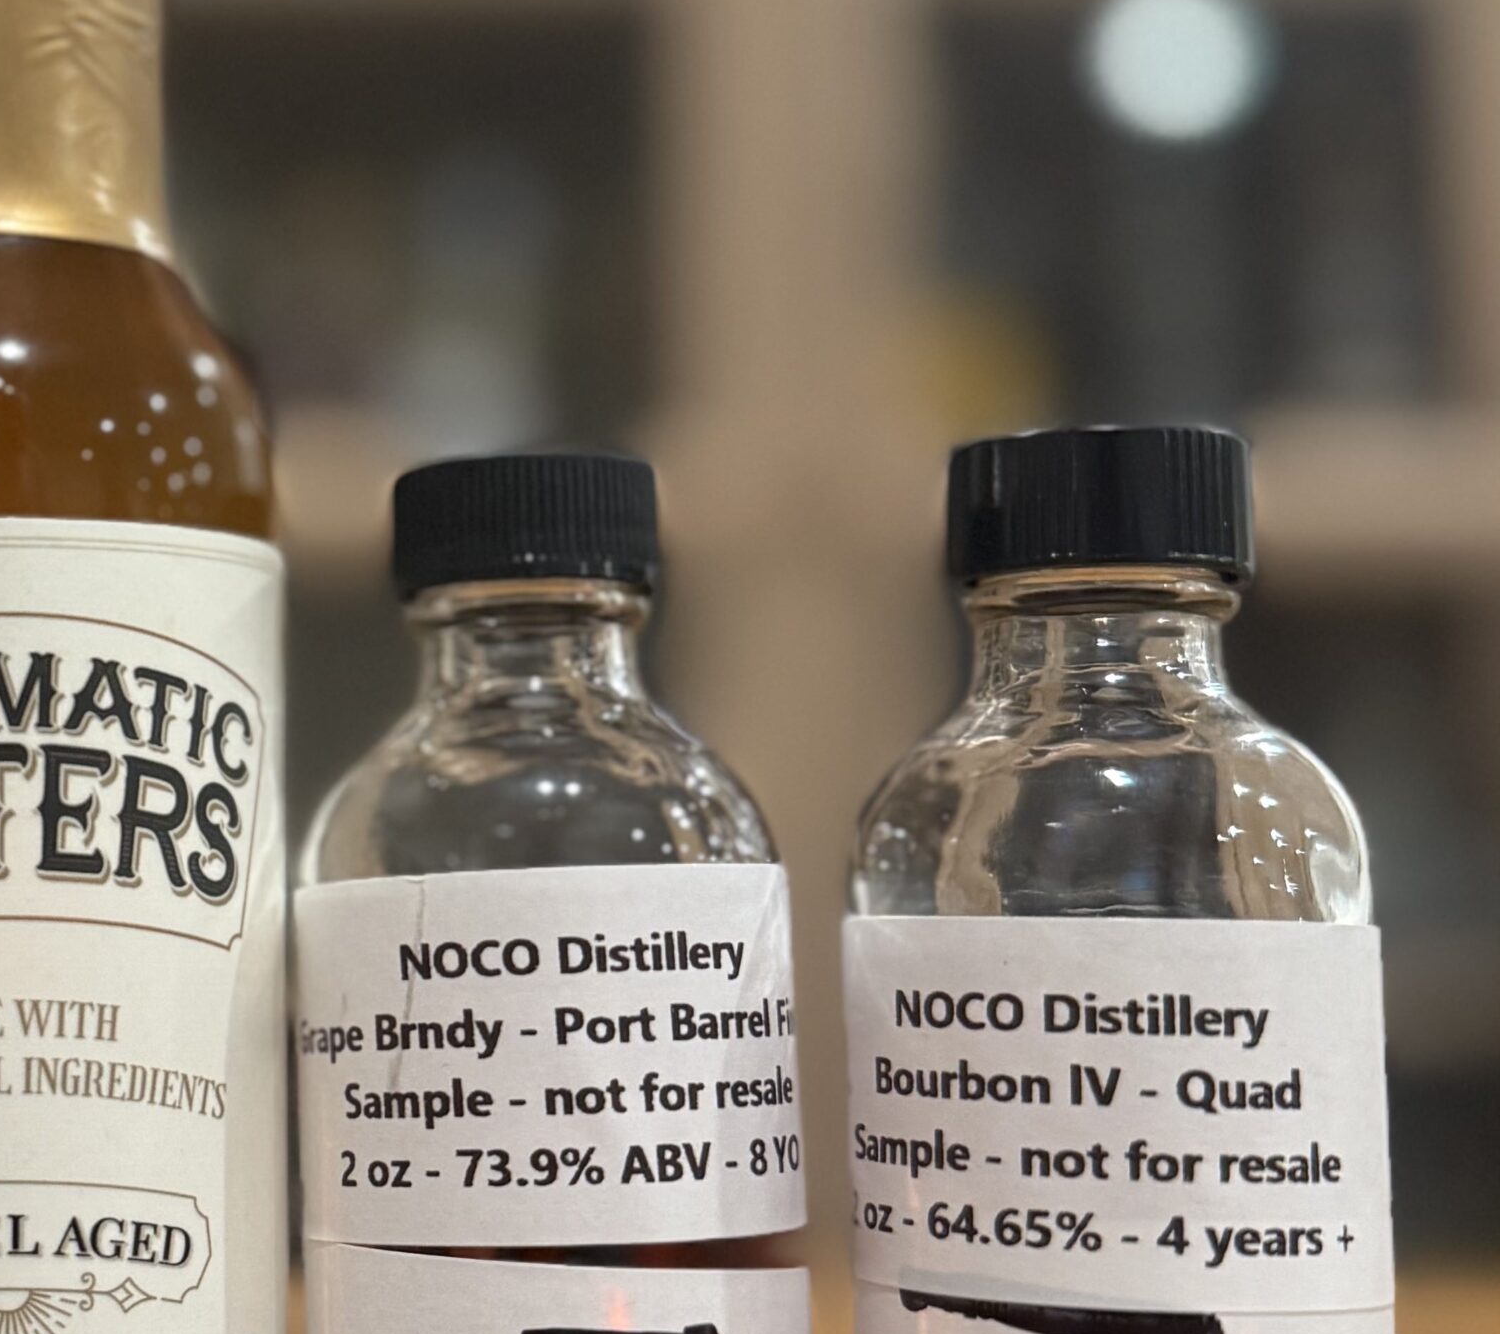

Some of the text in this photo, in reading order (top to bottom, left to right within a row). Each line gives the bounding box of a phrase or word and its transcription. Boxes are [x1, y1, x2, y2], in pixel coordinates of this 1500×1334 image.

[399, 930, 744, 981] NOCO Distillery
[14, 999, 121, 1042] WITH
[374, 1008, 504, 1060] Brndy
[554, 1006, 657, 1046] Port
[670, 997, 771, 1042] Barrel
[895, 988, 1269, 1049] NOCO Distillery
[22, 1056, 228, 1120] INGREDIENTS
[344, 1065, 793, 1130] Sample not for resale
[875, 1055, 1302, 1115] Bourbon IV Quad
[340, 1133, 799, 1188] 2 oz 73.9% ABV 8 YO
[855, 1122, 1341, 1185] Sample not for resale
[52, 1214, 194, 1268] AGED
[863, 1201, 894, 1234] oz
[927, 1200, 1102, 1253] 64.65%
[1157, 1215, 1190, 1257] 4
[1204, 1226, 1323, 1269] years
